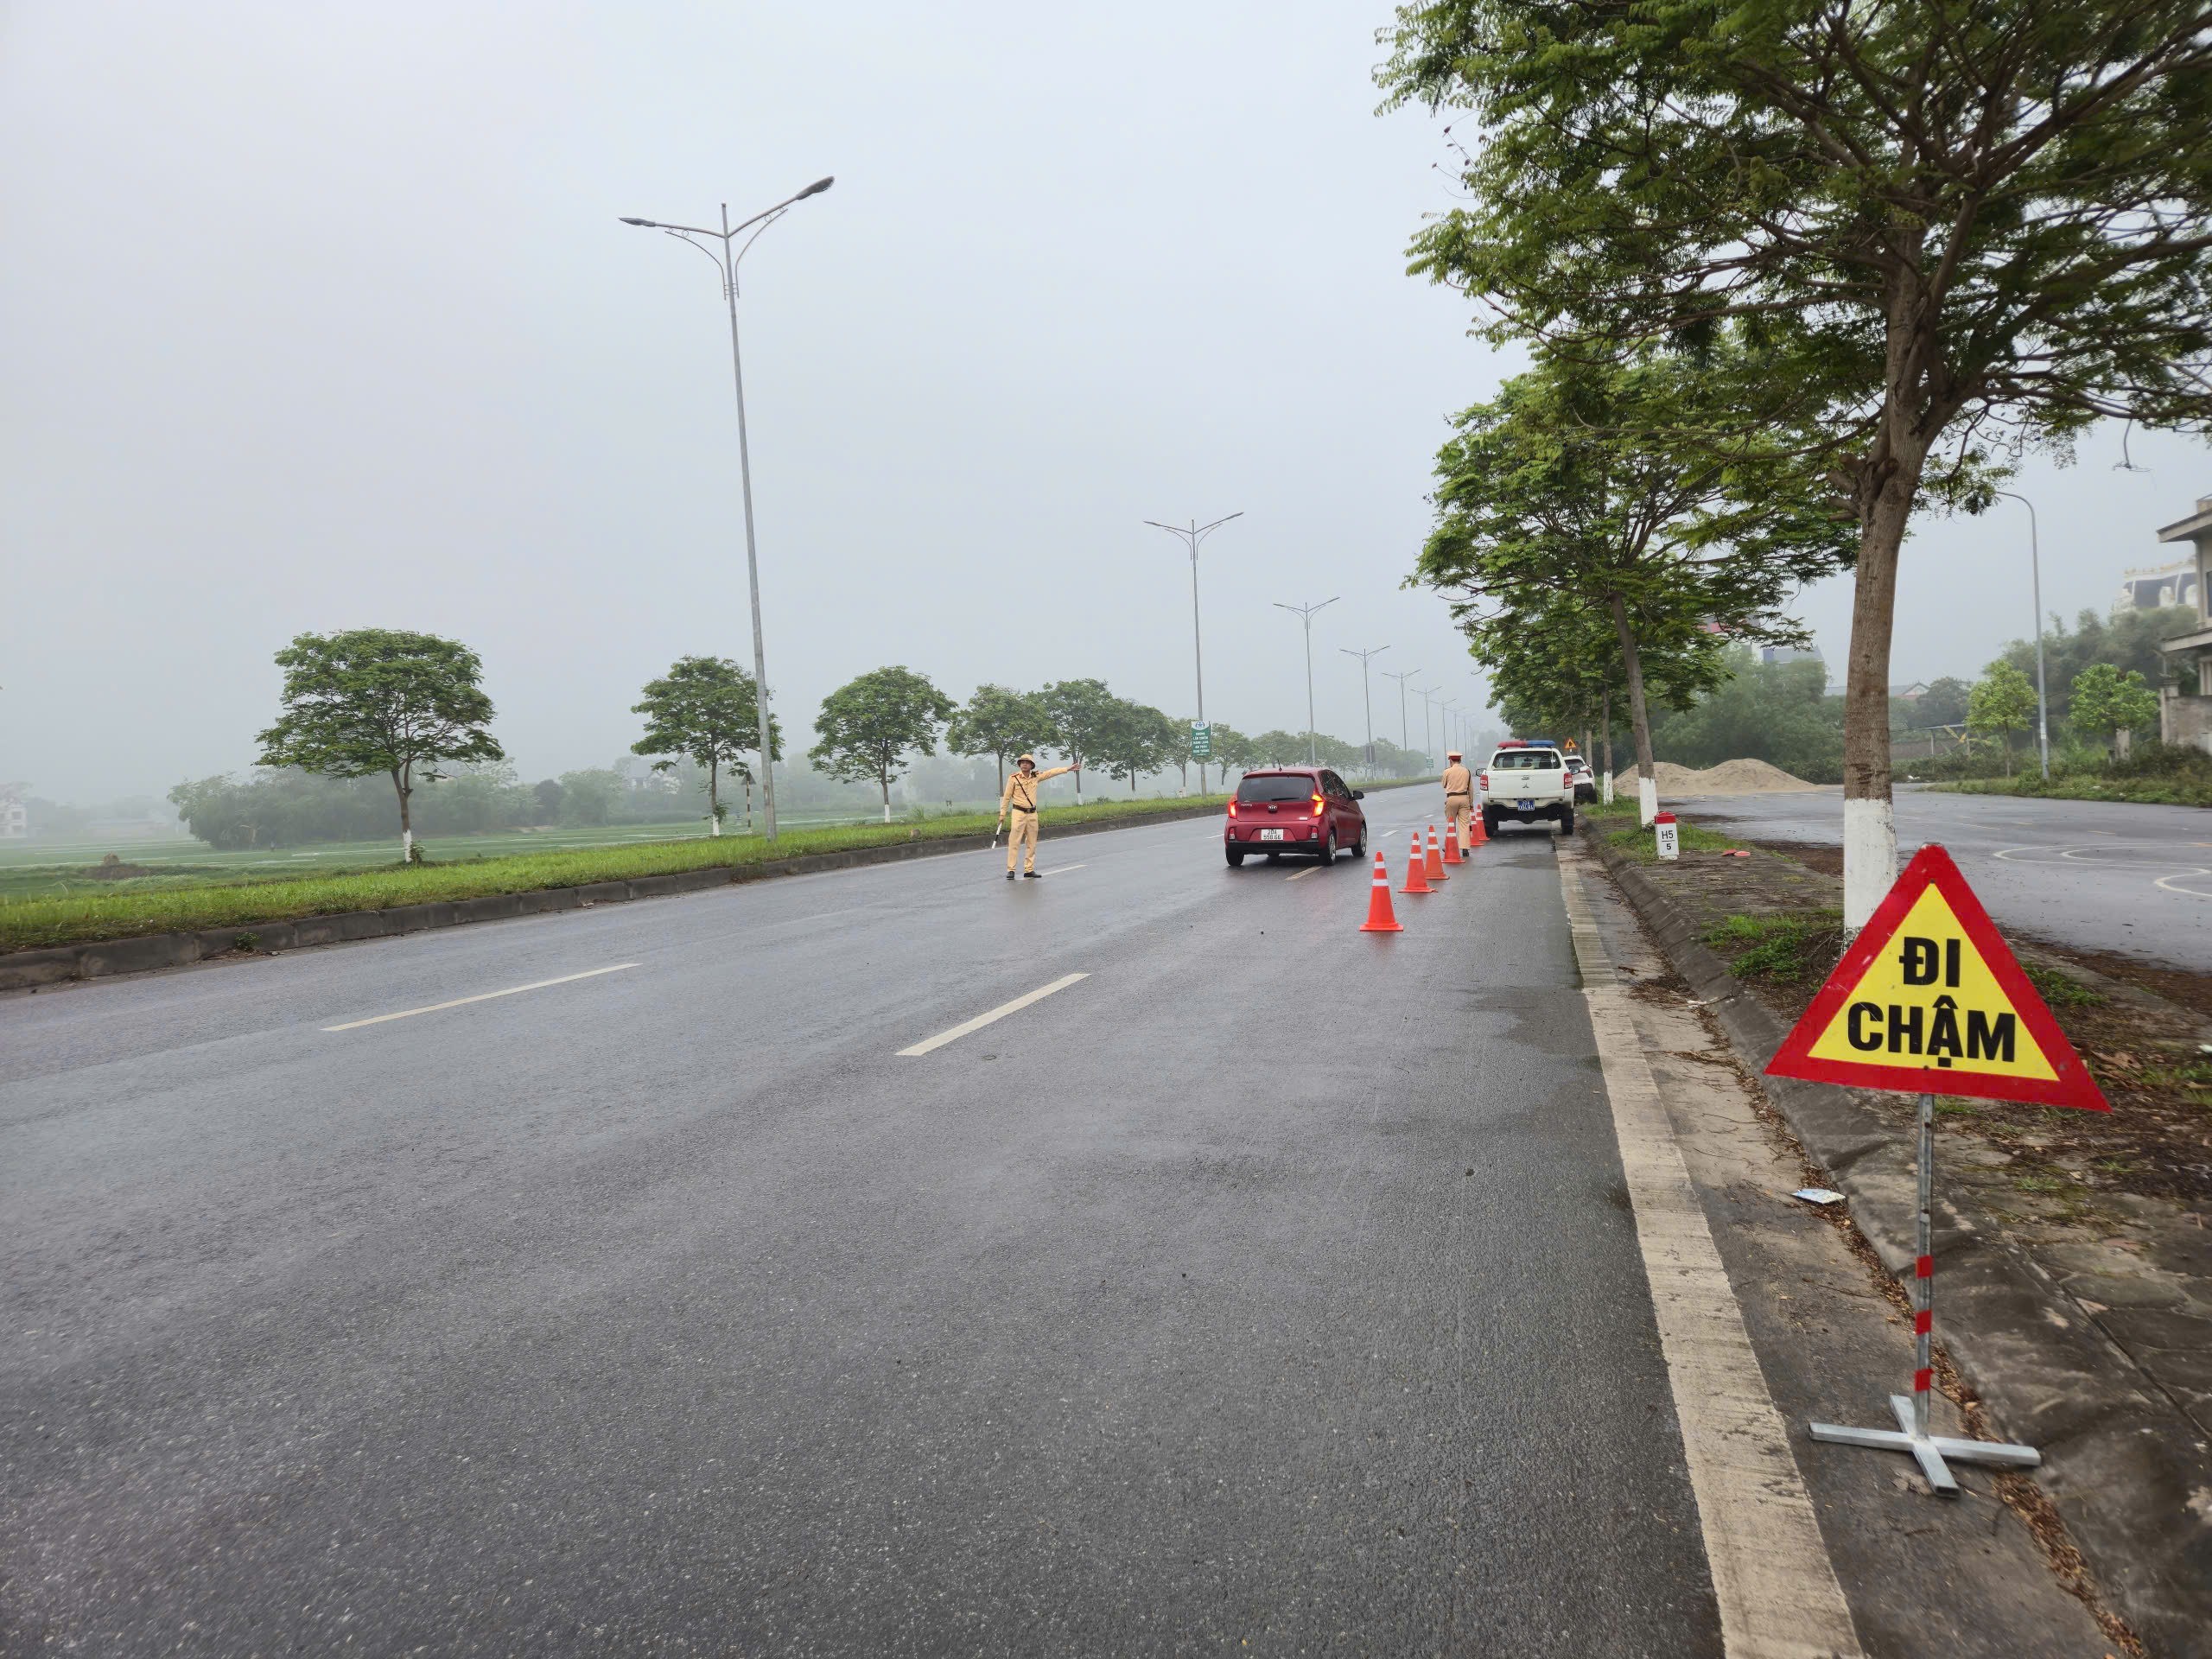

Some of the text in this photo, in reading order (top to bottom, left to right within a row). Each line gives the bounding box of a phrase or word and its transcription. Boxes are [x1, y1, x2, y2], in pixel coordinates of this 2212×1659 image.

[1662, 830, 1673, 839] H5
[1898, 936, 1961, 988] ĐI
[1847, 995, 2016, 1068] CHẬM
